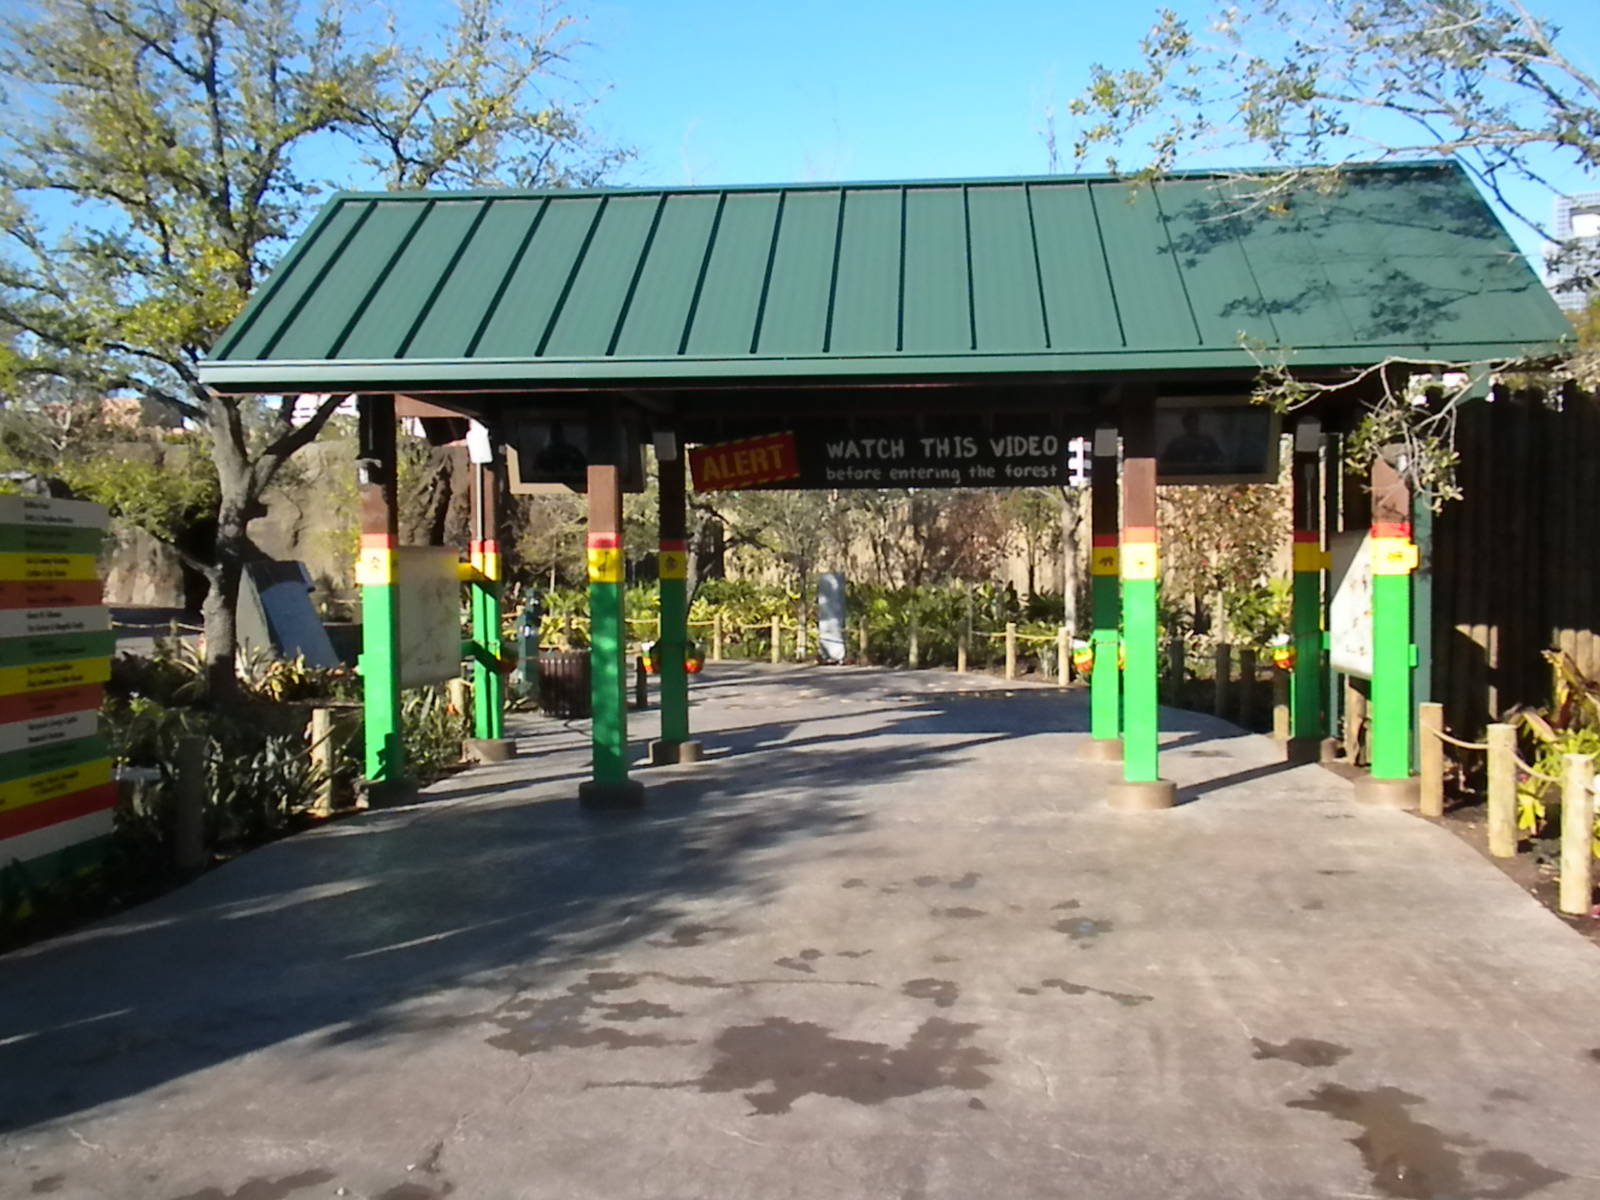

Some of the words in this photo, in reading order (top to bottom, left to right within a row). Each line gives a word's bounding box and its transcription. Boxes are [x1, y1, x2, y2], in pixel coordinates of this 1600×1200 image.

[825, 438, 905, 459] WATCH
[919, 435, 978, 459] THIS
[989, 435, 1059, 458] VIDEO
[702, 444, 785, 482] ALERT
[825, 465, 882, 481] before
[889, 466, 961, 485] entering
[968, 463, 996, 479] the
[1004, 463, 1058, 479] forest
